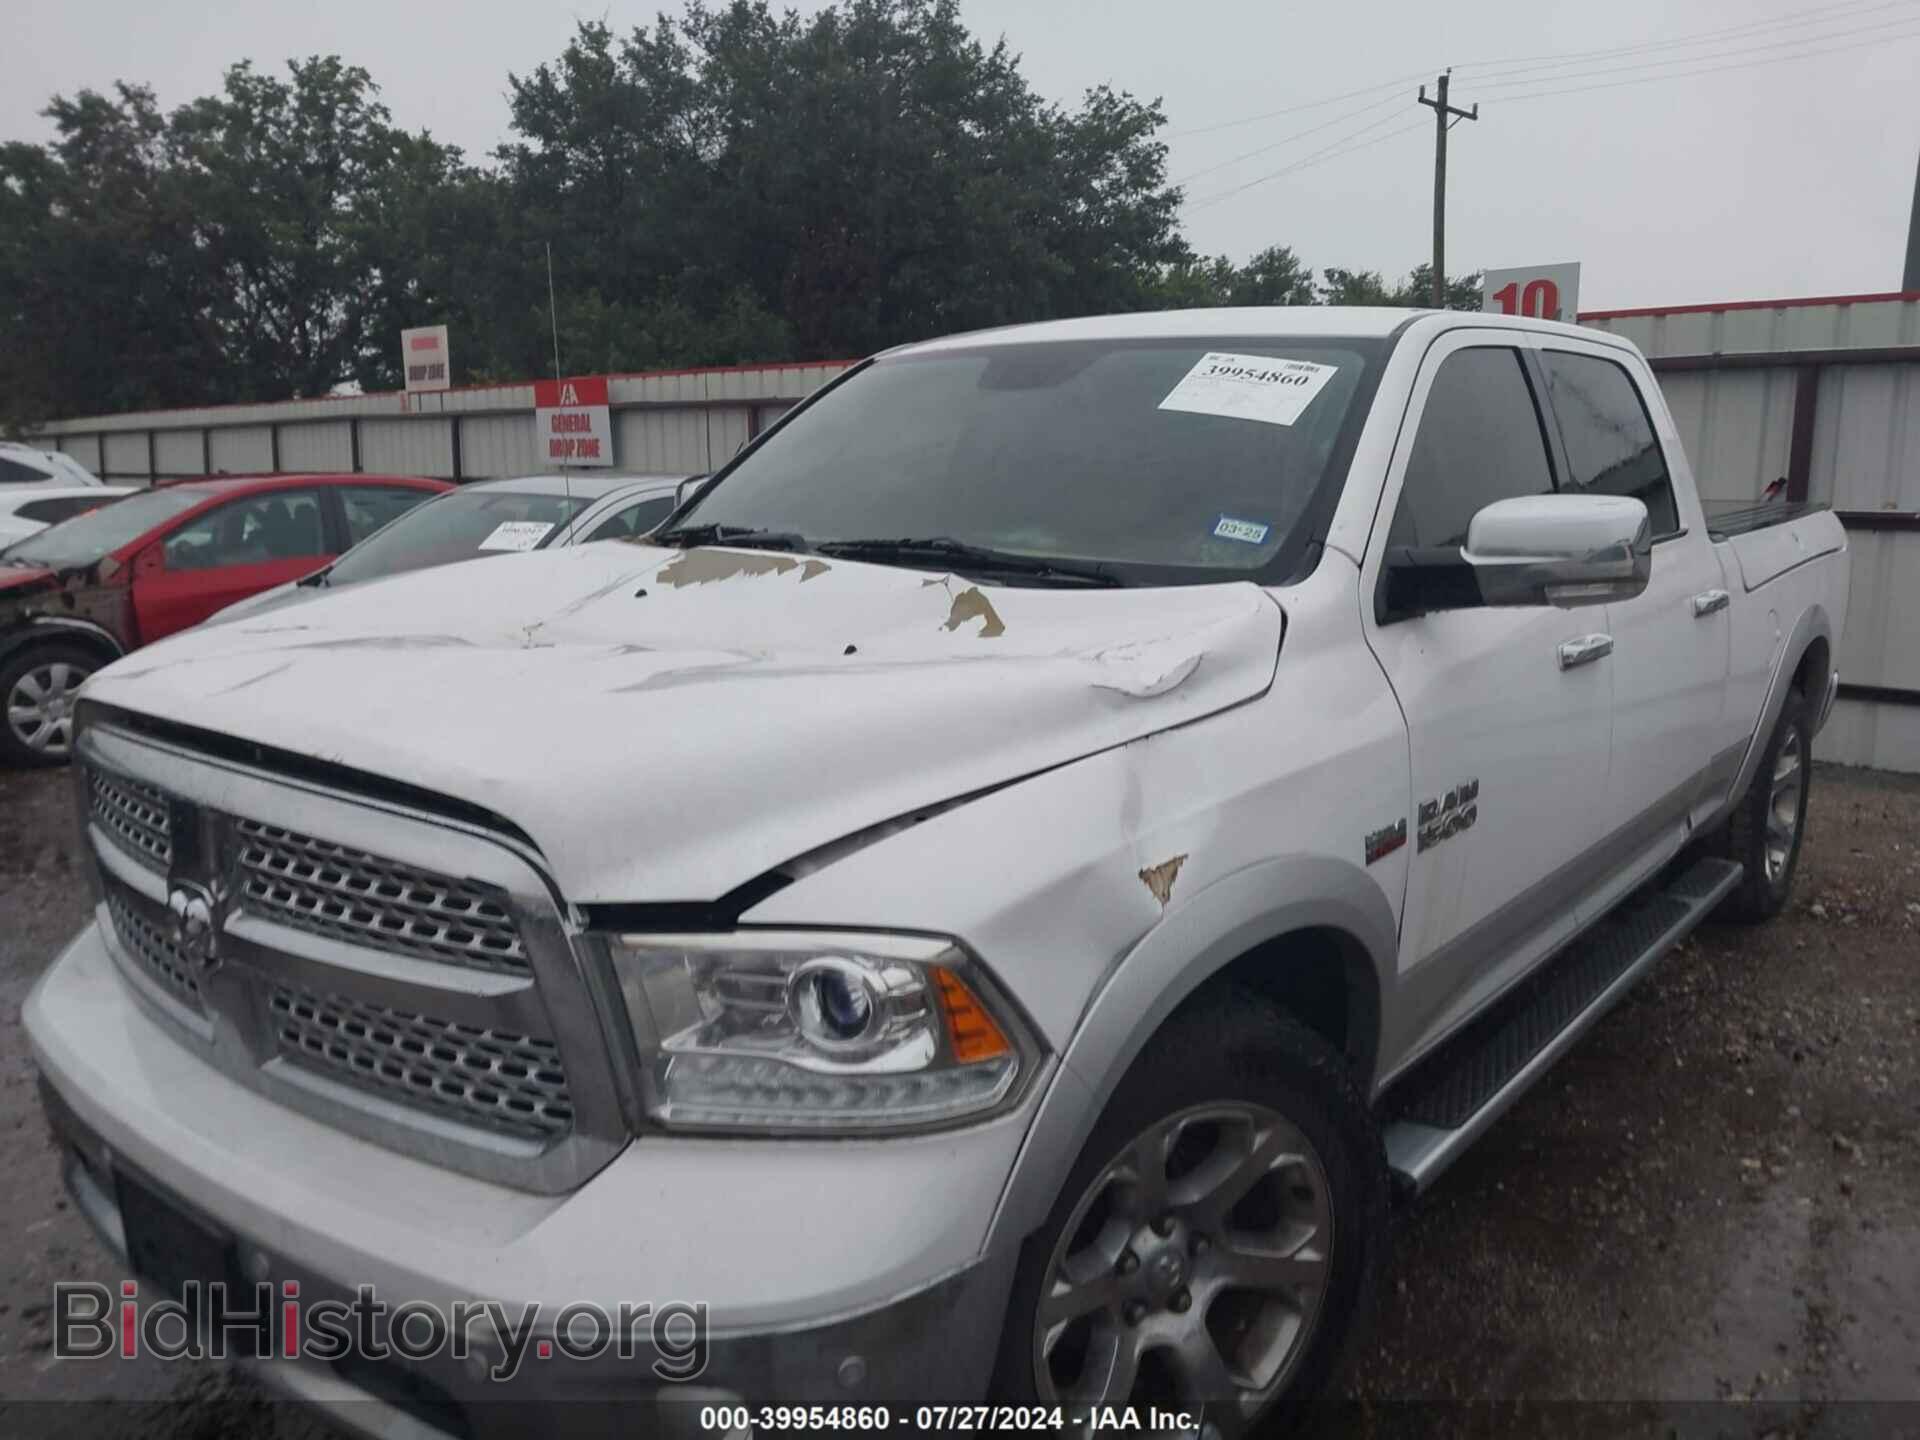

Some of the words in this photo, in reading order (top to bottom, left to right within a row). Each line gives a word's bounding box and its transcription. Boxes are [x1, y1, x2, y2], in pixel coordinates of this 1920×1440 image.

[1493, 280, 1557, 319] 10
[1202, 364, 1309, 386] 39954860
[551, 413, 592, 433] GENERAL
[549, 438, 575, 457] DROP
[576, 437, 600, 457] ZONE
[1418, 779, 1479, 826] RAM
